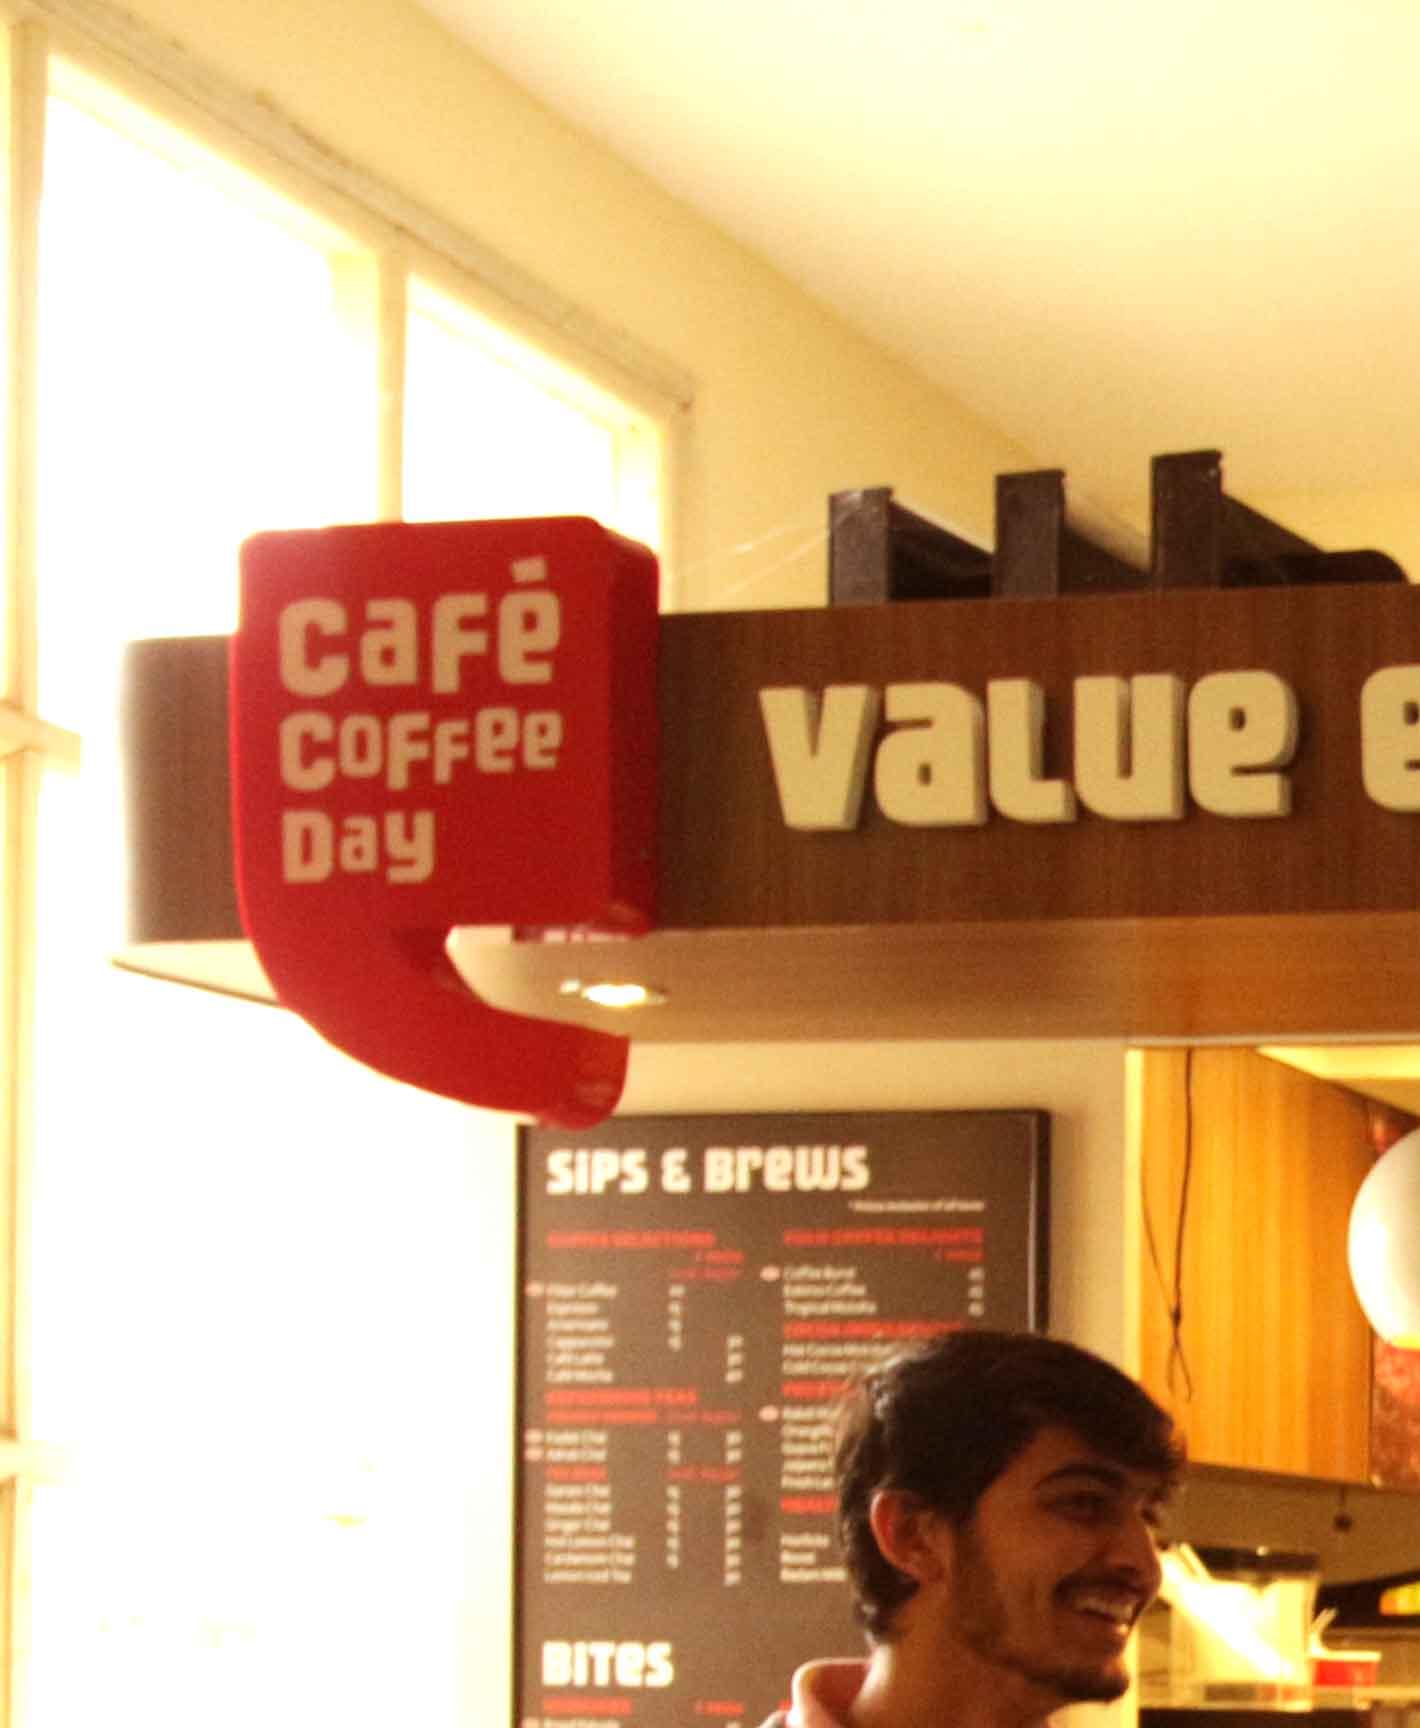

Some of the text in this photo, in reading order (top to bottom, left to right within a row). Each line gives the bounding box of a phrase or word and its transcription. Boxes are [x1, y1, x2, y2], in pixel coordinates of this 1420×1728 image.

[278, 556, 562, 697] Café
[279, 706, 564, 791] Coffee
[758, 668, 1296, 830] value
[281, 809, 436, 884] Day
[660, 1147, 692, 1194] &
